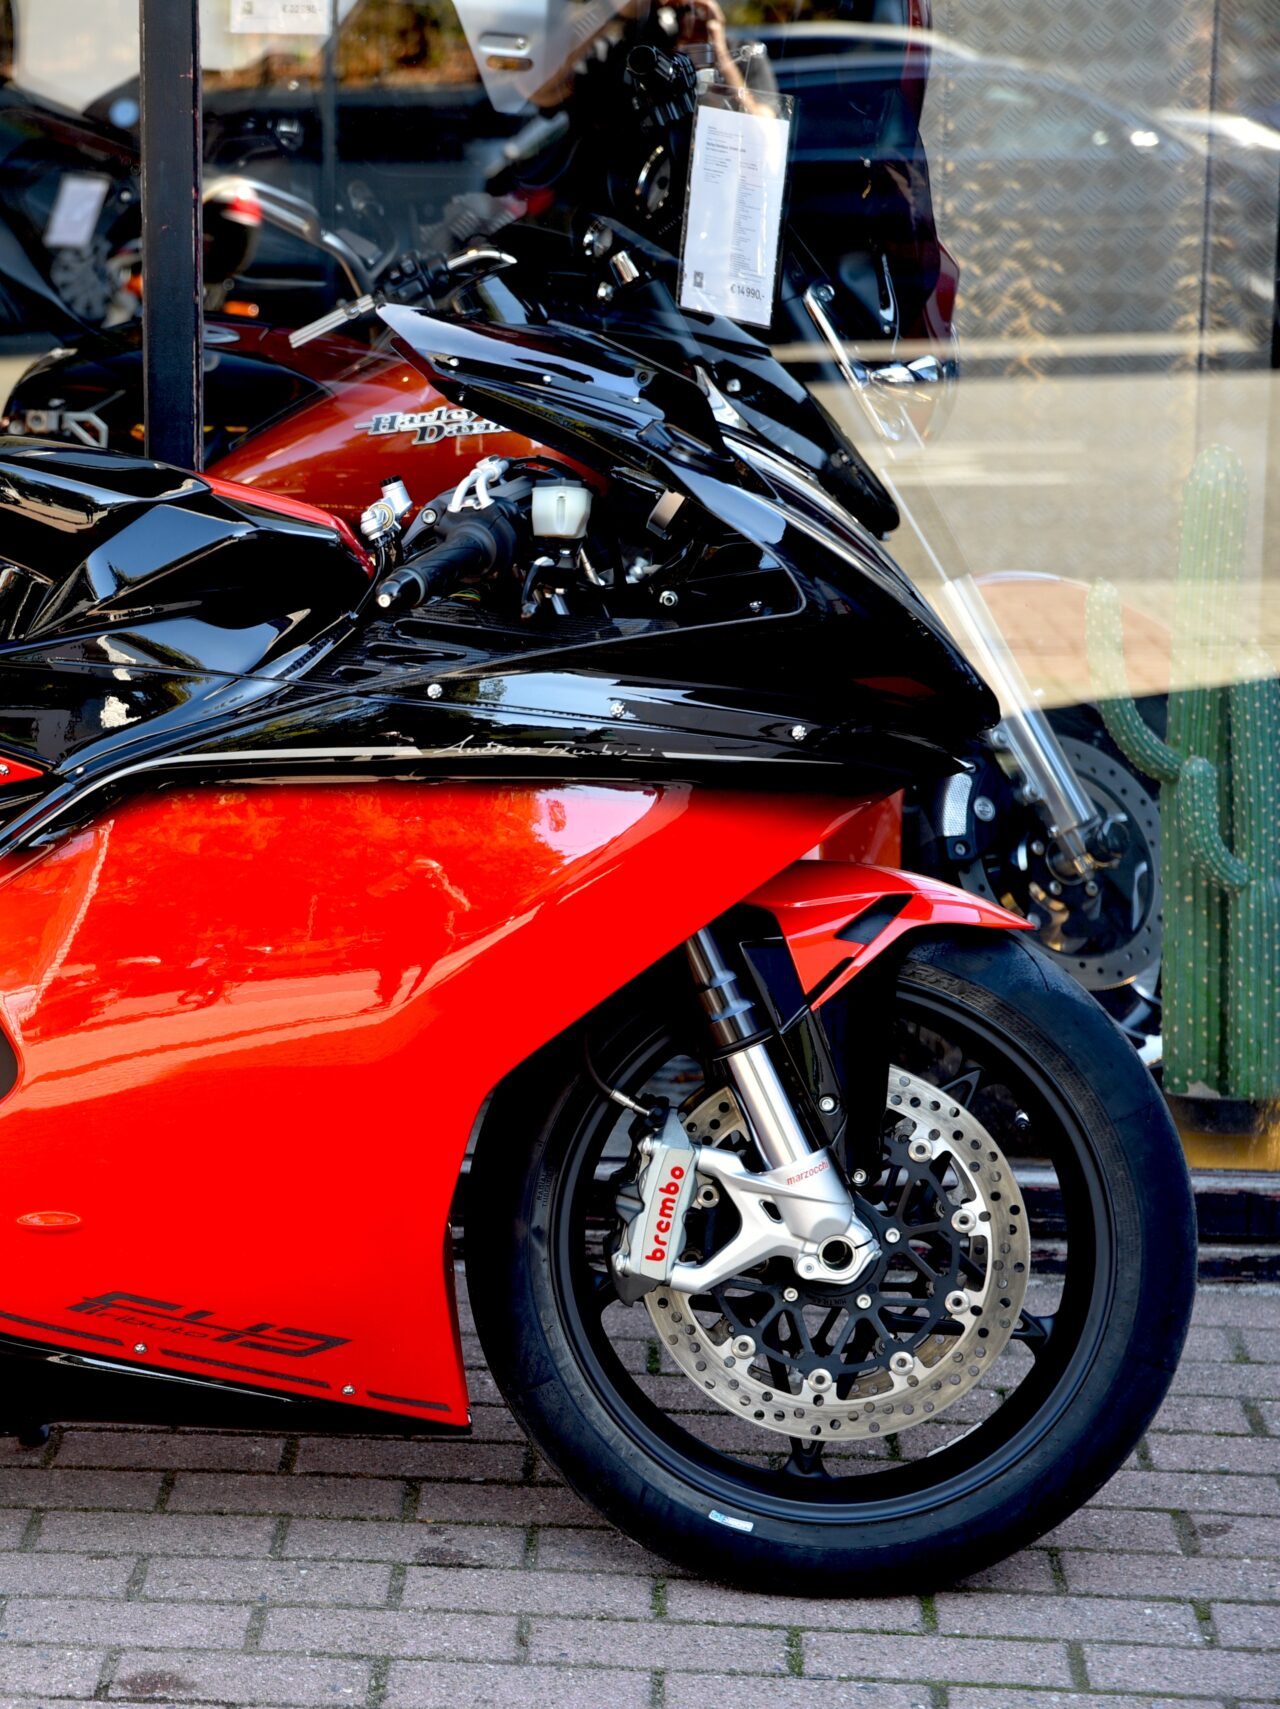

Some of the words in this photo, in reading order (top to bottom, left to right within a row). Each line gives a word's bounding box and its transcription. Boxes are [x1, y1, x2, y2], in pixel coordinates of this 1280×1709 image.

[368, 406, 479, 435] Harley
[786, 1159, 829, 1186] marzocchi
[645, 1166, 685, 1262] brembo
